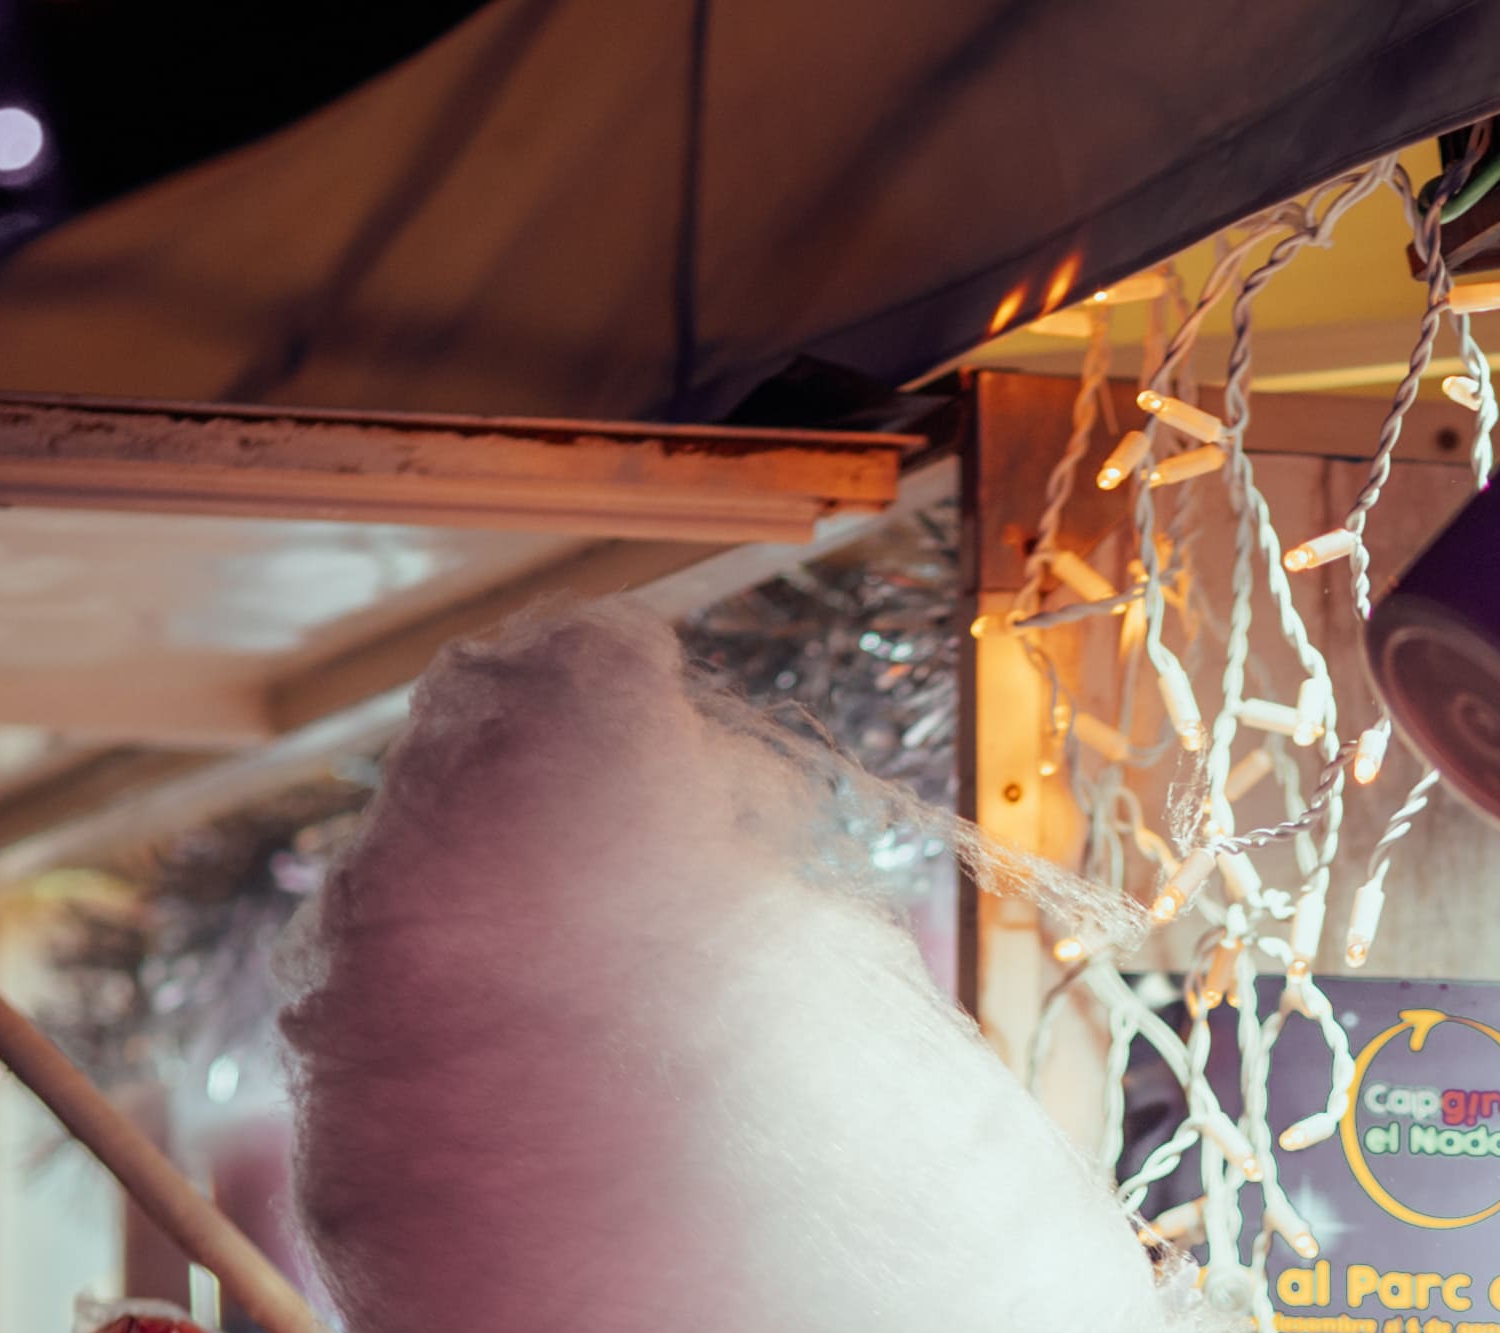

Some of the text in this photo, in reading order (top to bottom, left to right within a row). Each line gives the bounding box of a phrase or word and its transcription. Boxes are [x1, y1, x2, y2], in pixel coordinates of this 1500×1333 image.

[1364, 1121, 1400, 1154] el
[1277, 1259, 1331, 1307] al
[1347, 1264, 1472, 1312] Parc
